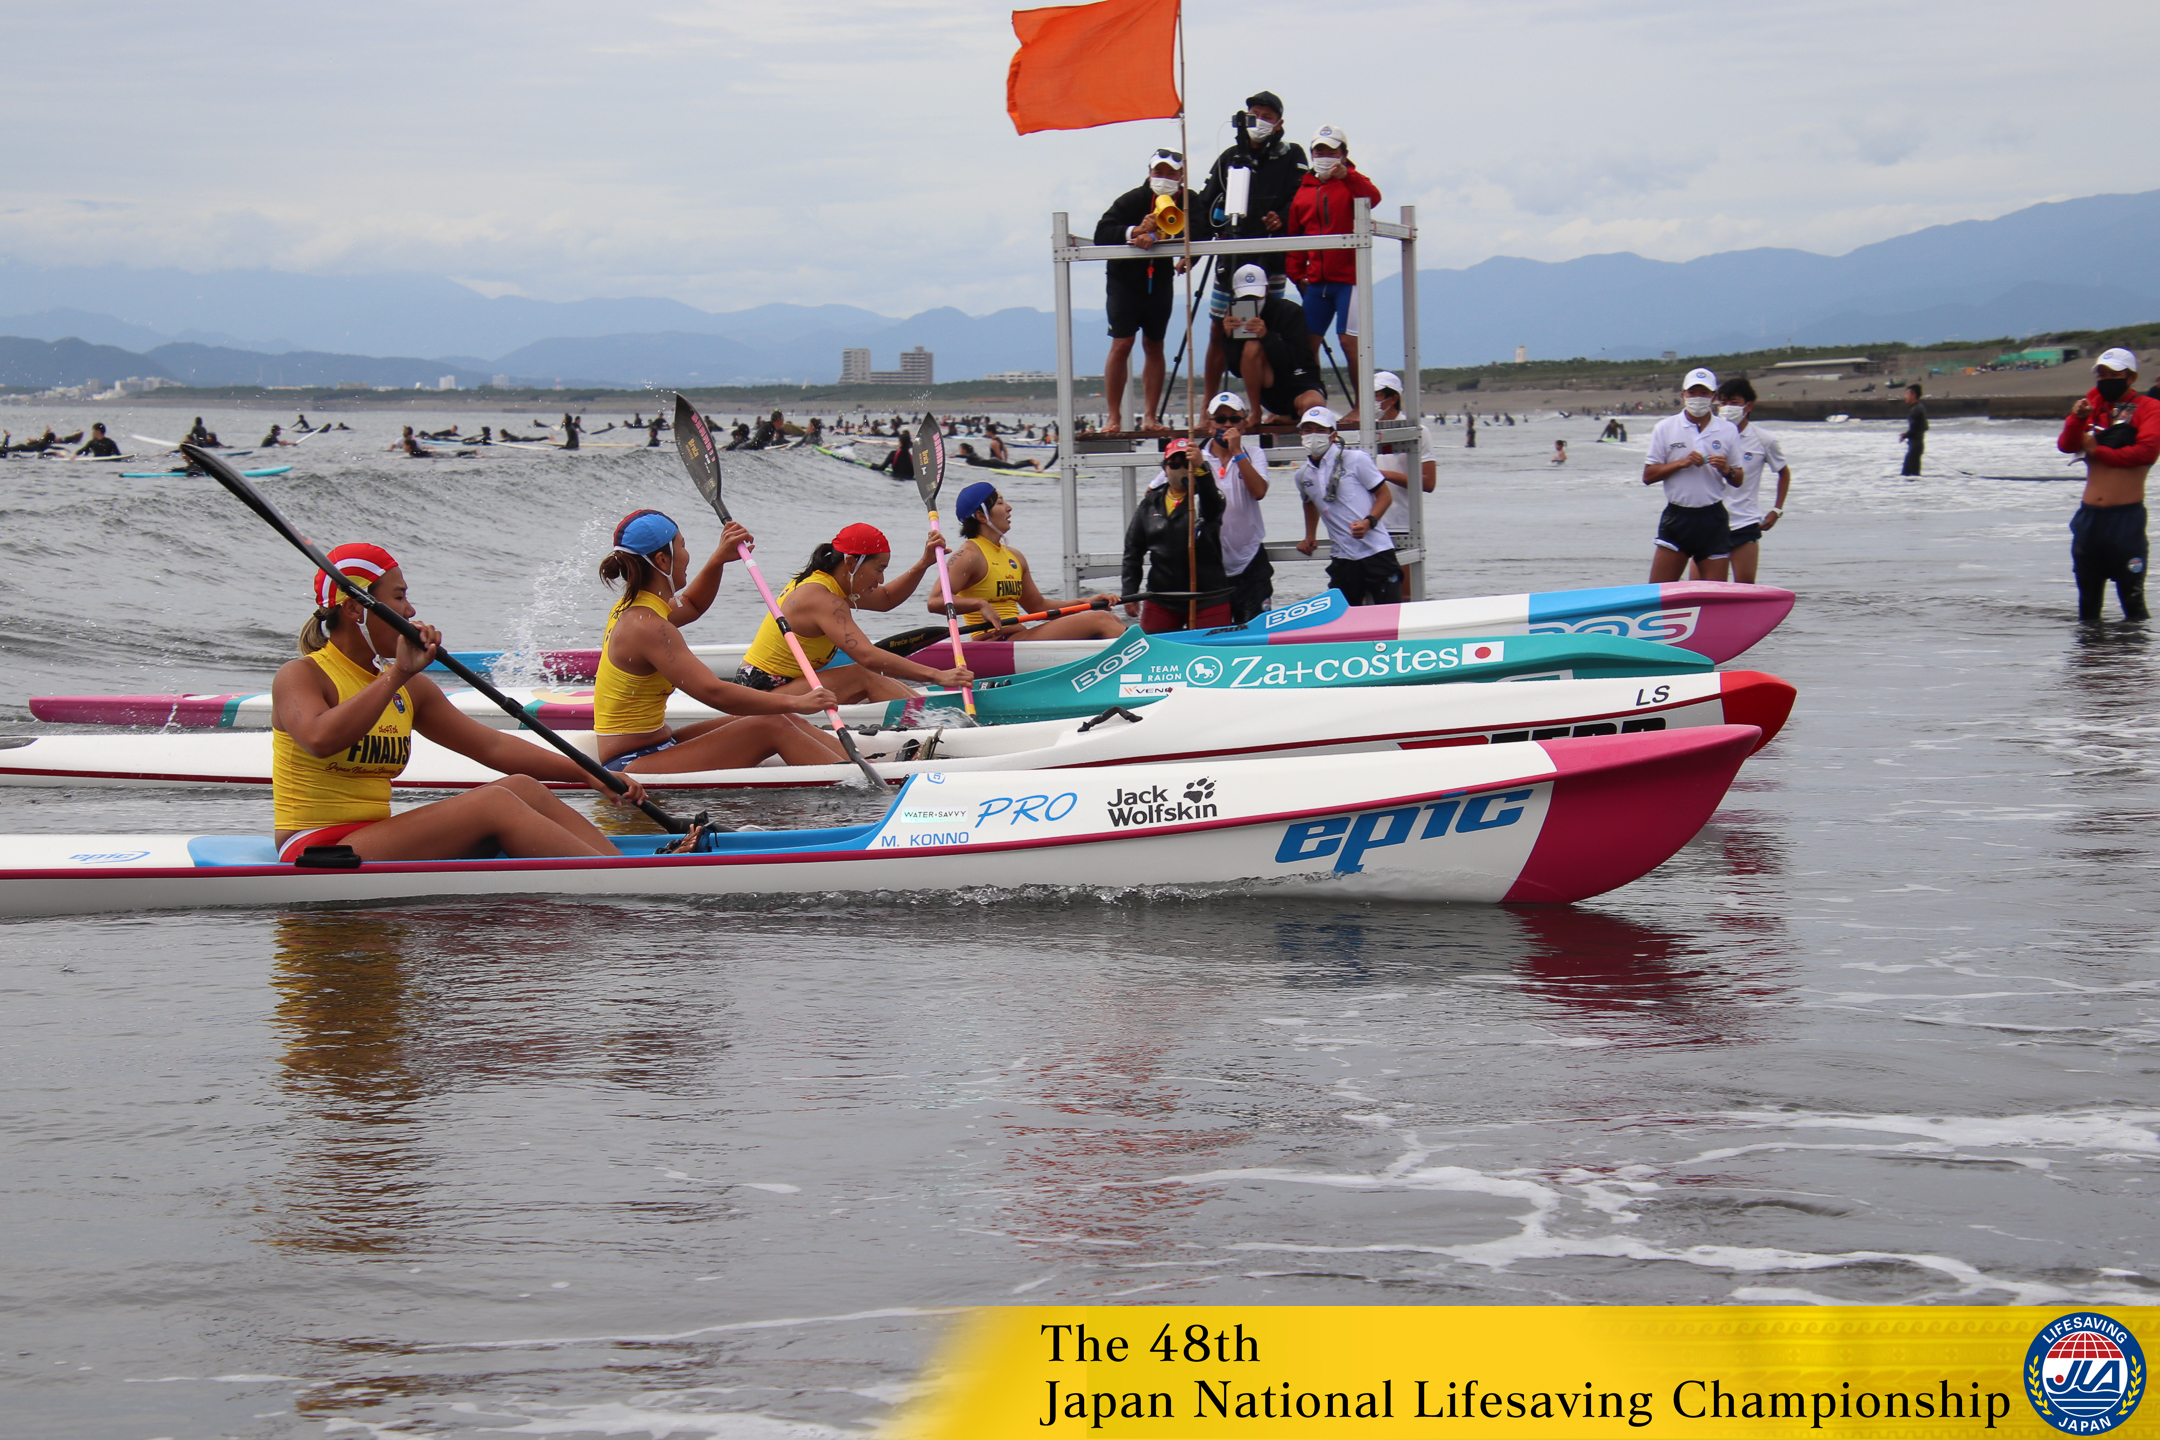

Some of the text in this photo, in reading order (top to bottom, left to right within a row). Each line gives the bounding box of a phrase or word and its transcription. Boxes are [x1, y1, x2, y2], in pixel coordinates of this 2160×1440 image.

[1266, 597, 1331, 628] BOS
[1071, 637, 1150, 693] BOS
[1148, 673, 1182, 682] RAION
[1151, 665, 1179, 673] TEAM
[1636, 685, 1670, 706] LS
[347, 735, 411, 765] FINALIS
[1107, 785, 1168, 807] Jack
[974, 792, 1078, 828] PRO
[1107, 802, 1217, 827] Wolfskin
[881, 832, 969, 847] M. KONNO
[1275, 789, 1534, 875] epic
